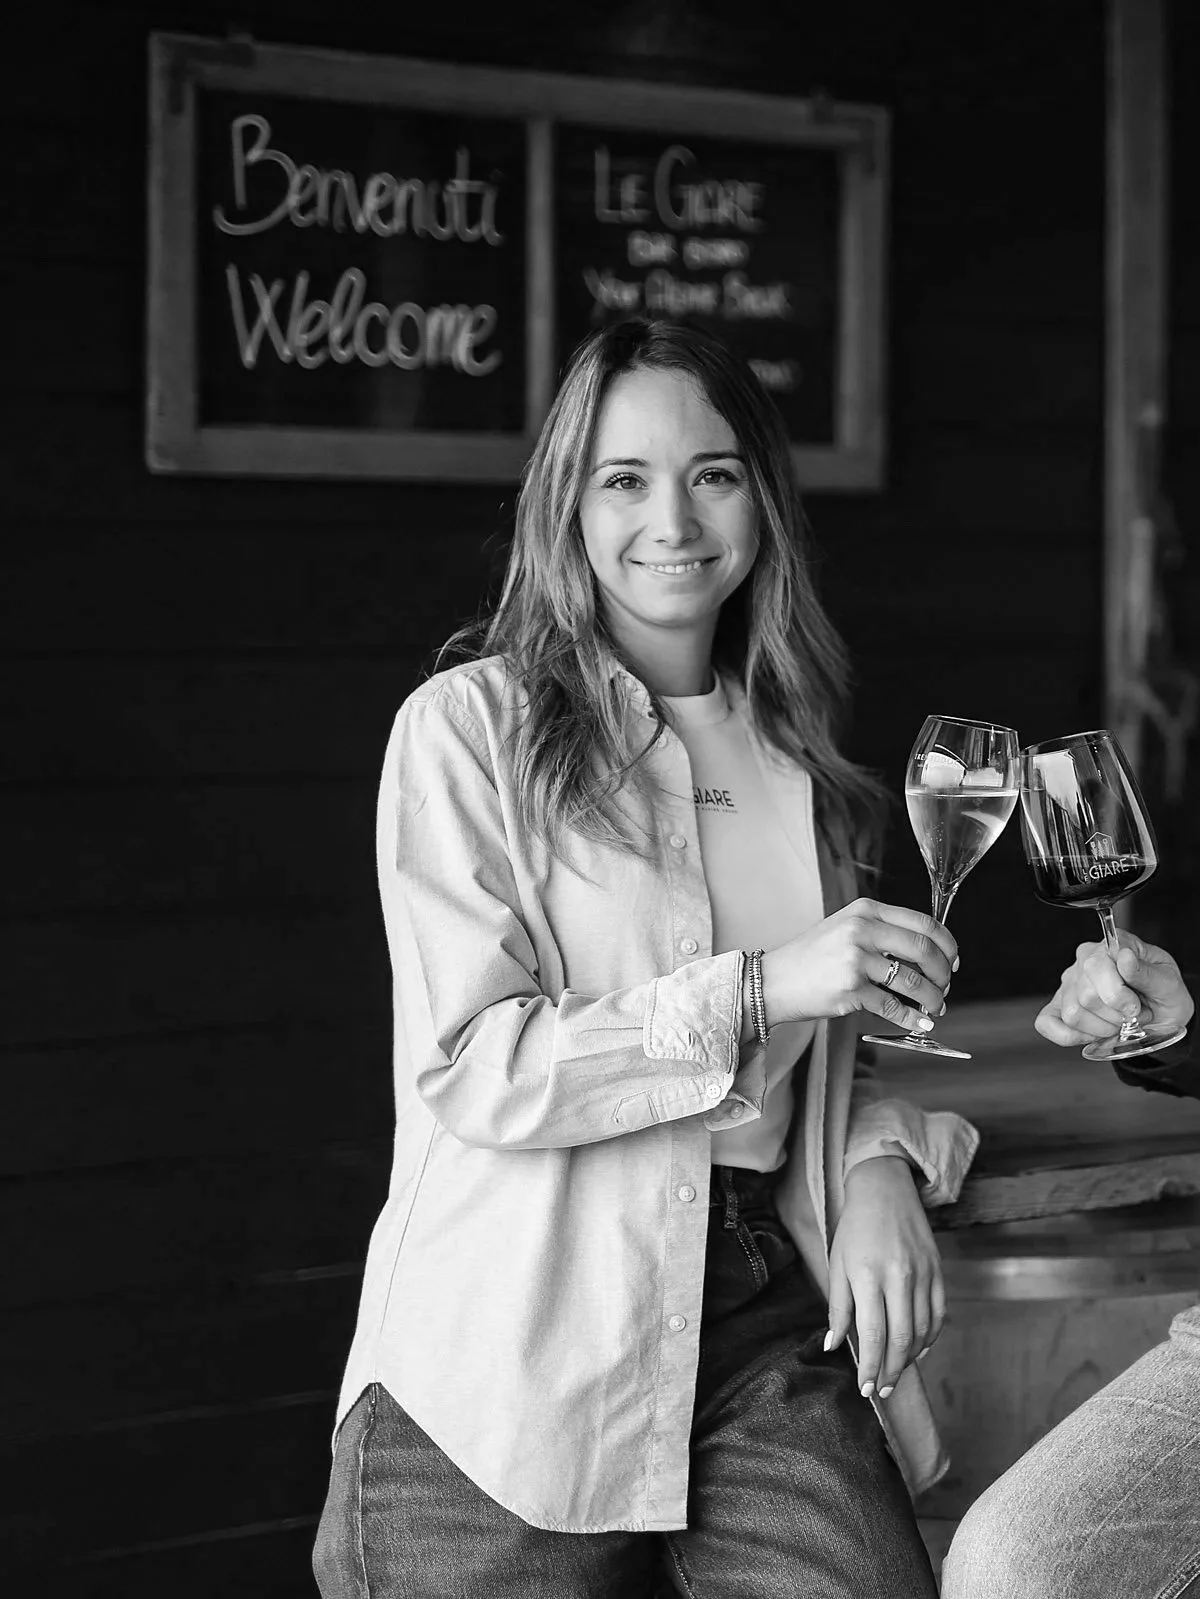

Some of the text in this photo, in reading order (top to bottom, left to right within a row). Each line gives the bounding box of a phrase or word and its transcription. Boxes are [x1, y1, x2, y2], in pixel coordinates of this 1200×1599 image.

[212, 113, 503, 247] Benvenuti
[225, 262, 502, 377] Welcome
[1088, 857, 1129, 880] GIARE
